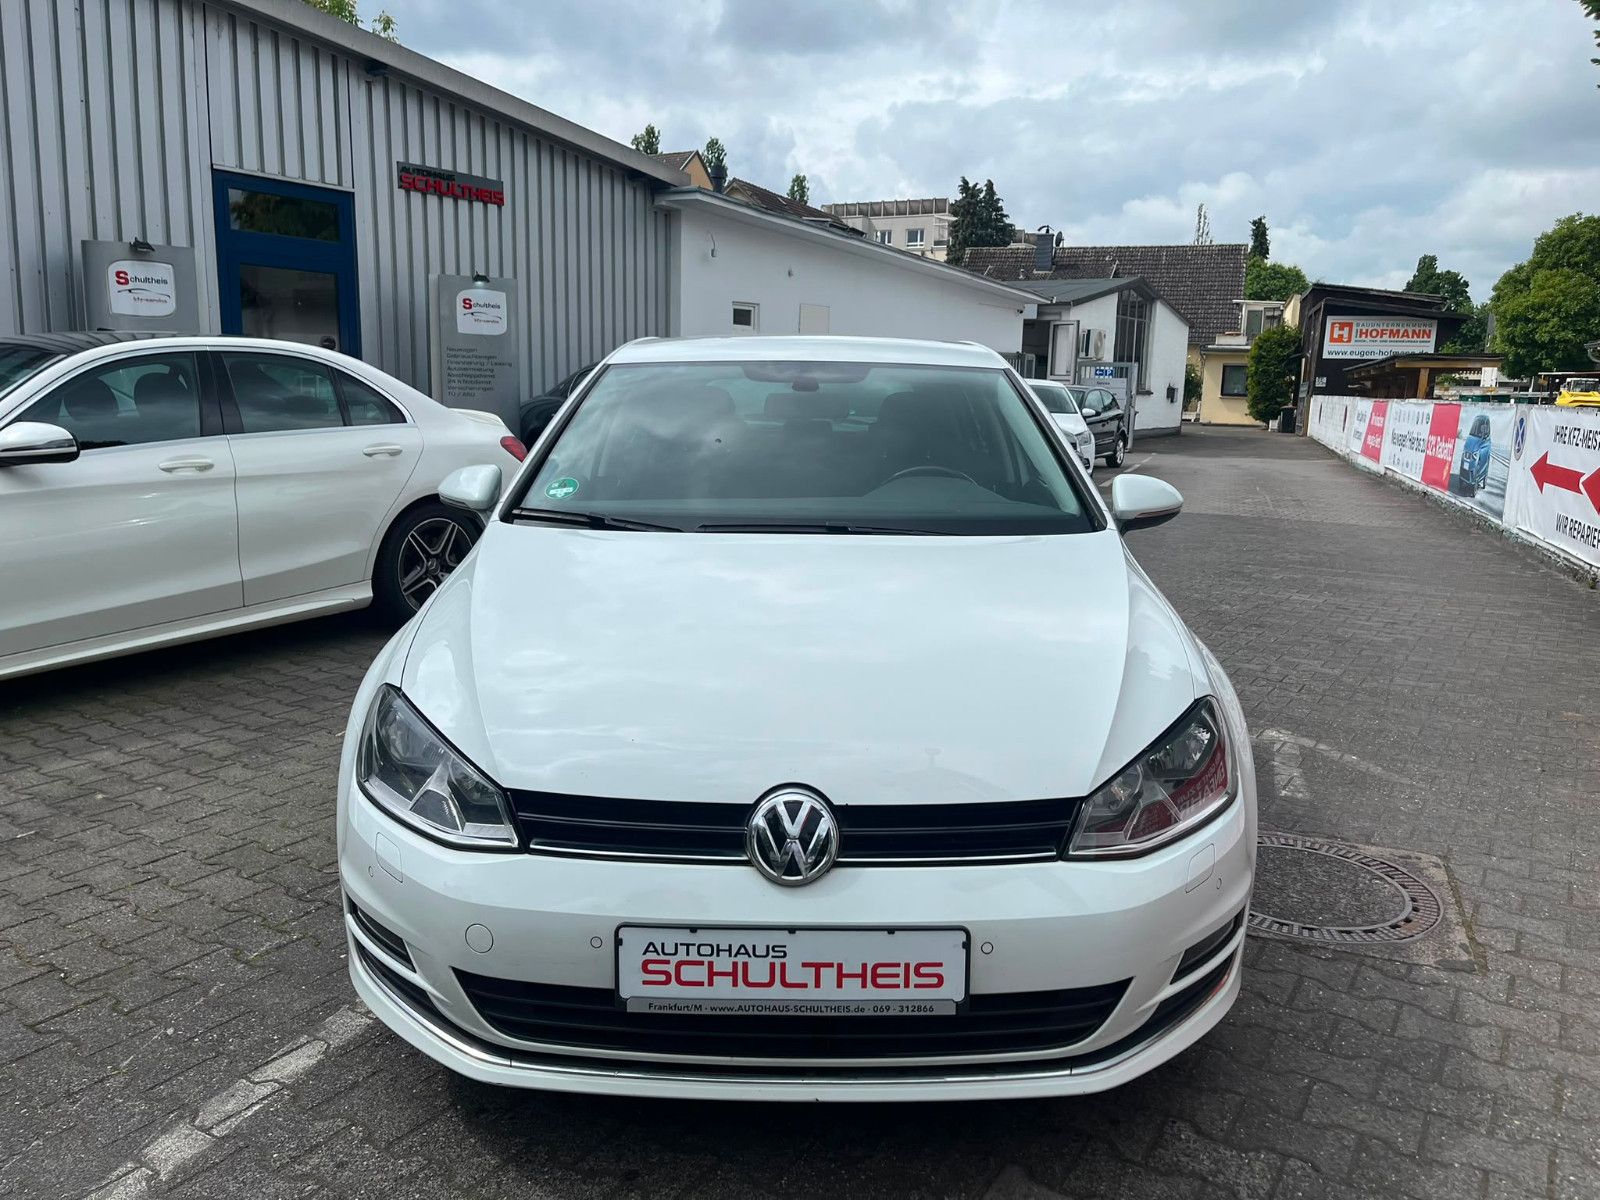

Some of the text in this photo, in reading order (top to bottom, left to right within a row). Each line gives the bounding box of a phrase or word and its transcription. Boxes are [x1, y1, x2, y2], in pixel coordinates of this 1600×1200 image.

[401, 173, 504, 205] SCHULTHEIS
[115, 270, 168, 285] Schultheis
[462, 298, 501, 310] Schultheis
[1356, 320, 1433, 328] BAUUNTERNEHMUNG
[1358, 328, 1432, 339] HOFMANN
[1327, 349, 1429, 358] www.eugen-hofmannd
[1553, 425, 1568, 444] IHRE
[1555, 513, 1568, 536] WIR
[642, 941, 788, 959] AUTOHAUS
[641, 959, 945, 990] SCHULTHEIS
[648, 1003, 935, 1013] Frankfurt/M www.AUTOHAUS-SCHULTHEIS.de 069 312866
